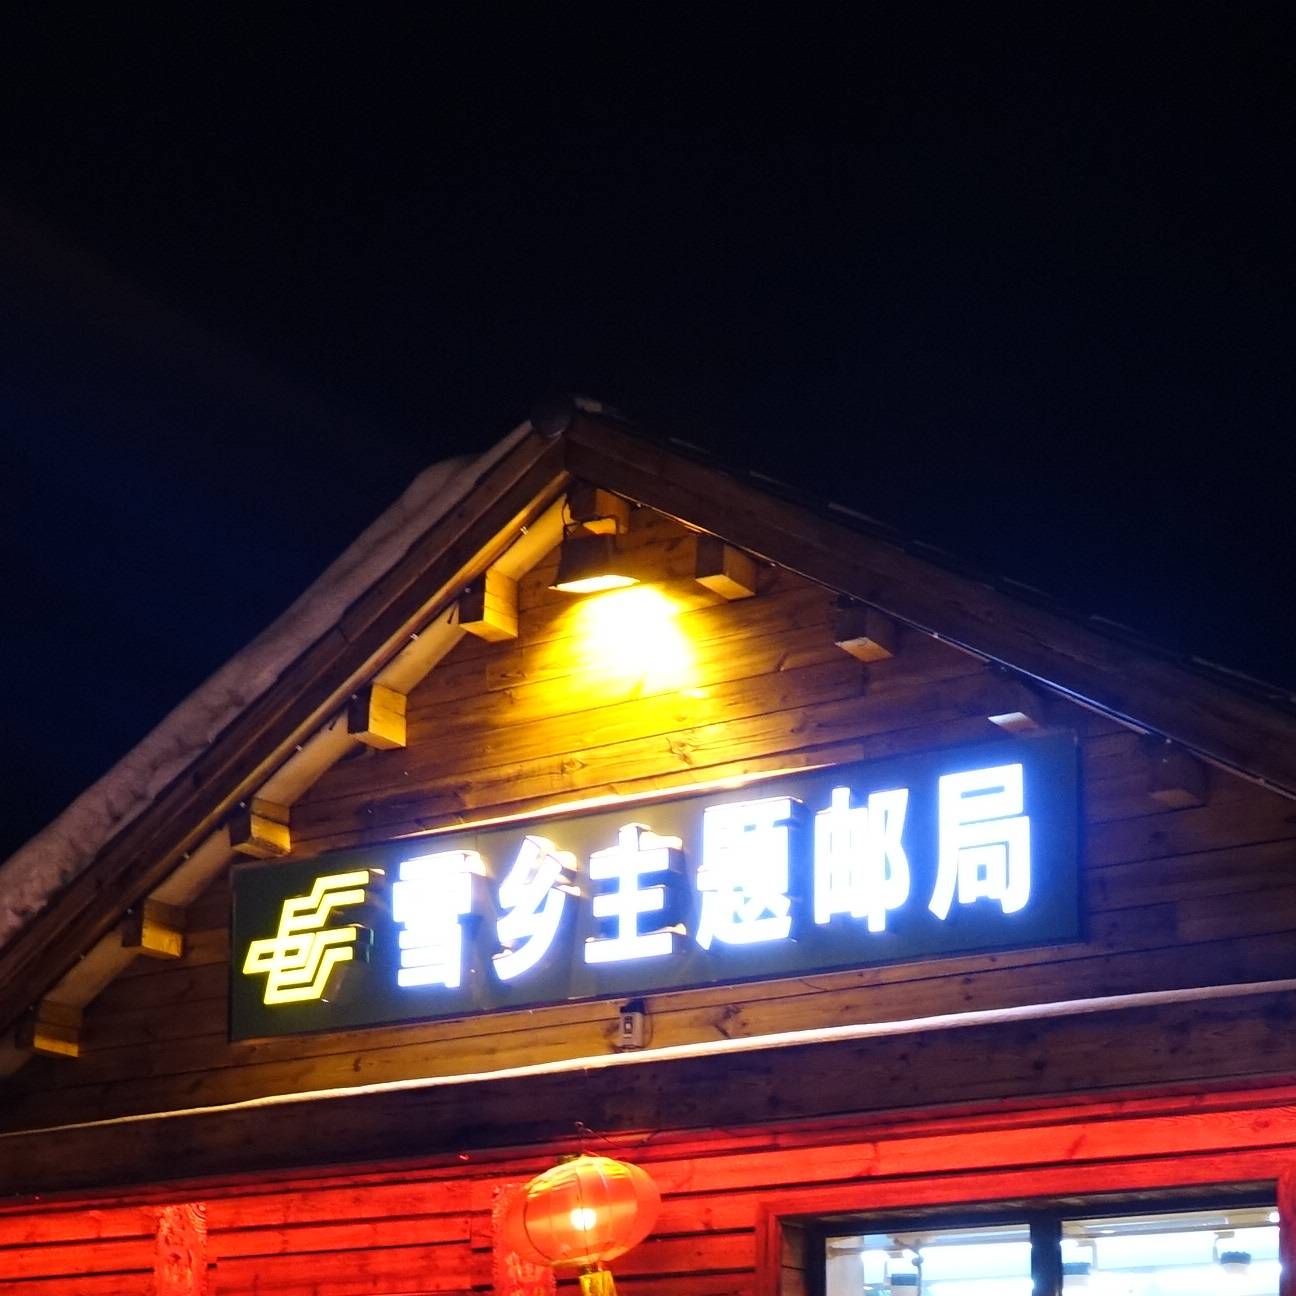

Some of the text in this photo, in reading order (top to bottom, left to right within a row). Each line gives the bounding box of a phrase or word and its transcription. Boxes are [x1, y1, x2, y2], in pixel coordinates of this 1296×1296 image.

[390, 763, 1034, 988] 雪乡主题邮局
